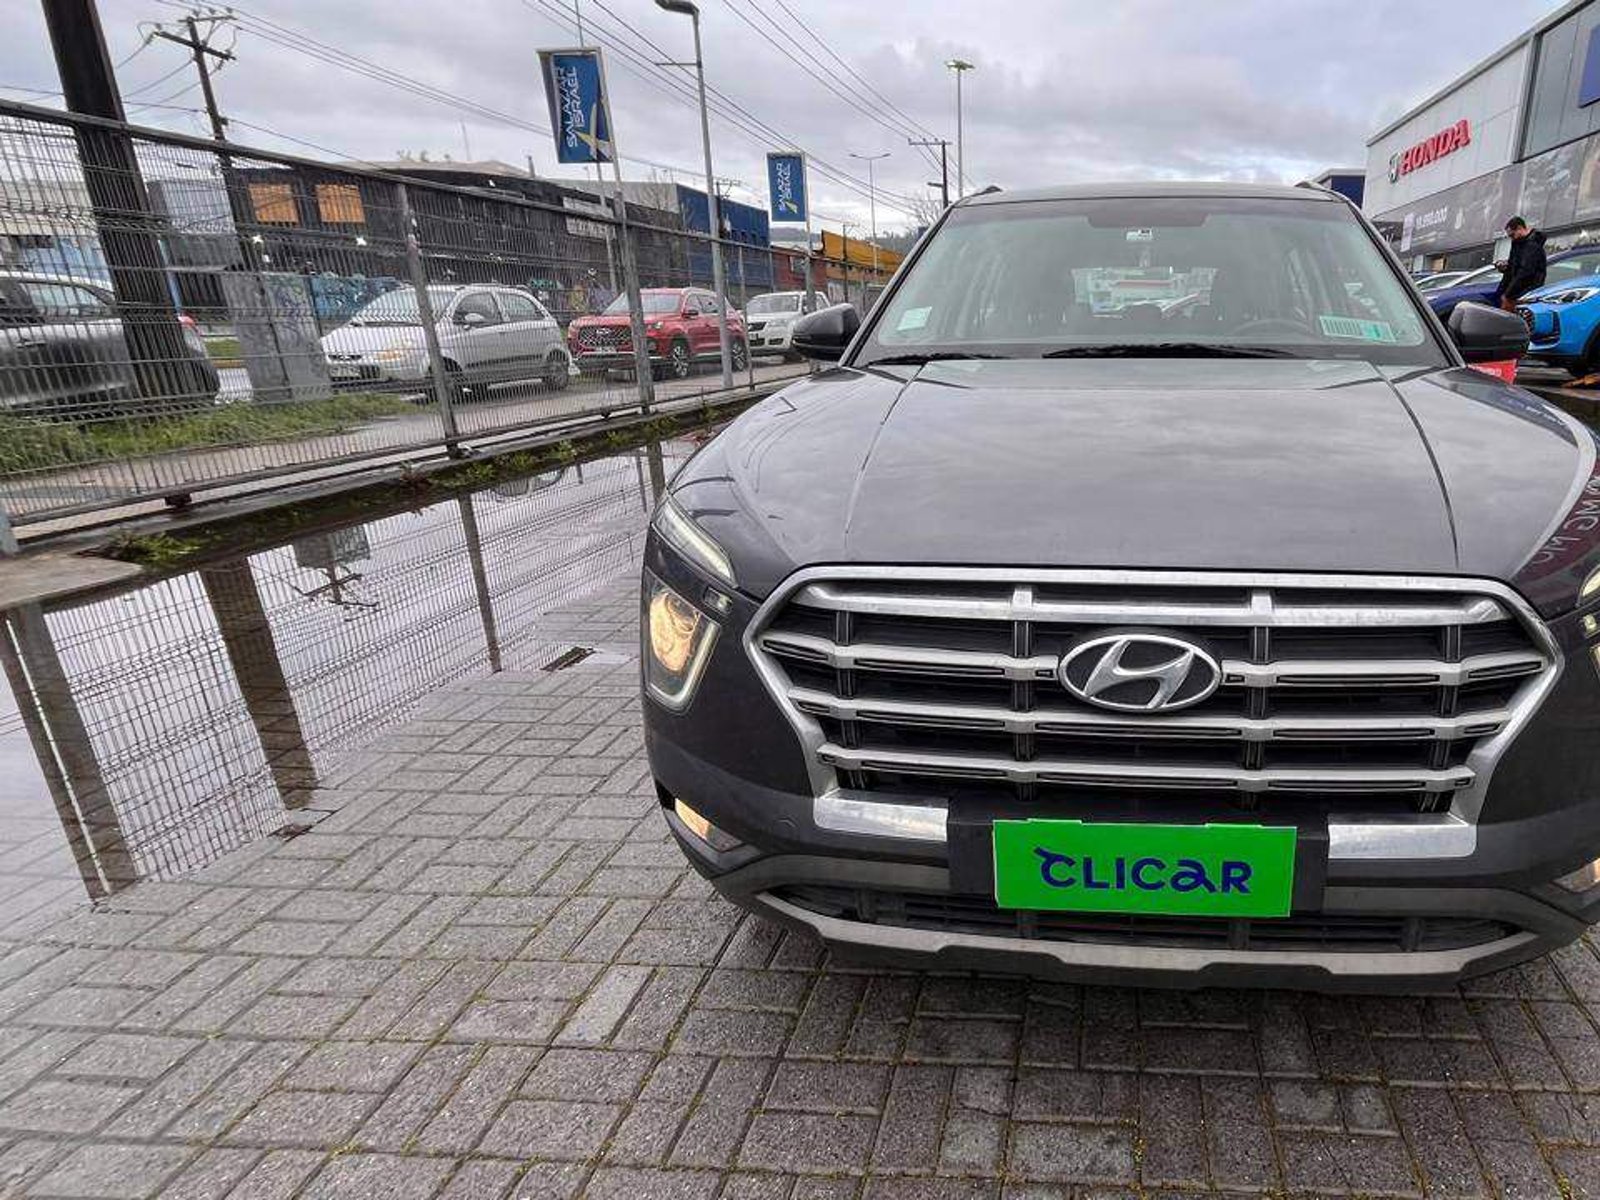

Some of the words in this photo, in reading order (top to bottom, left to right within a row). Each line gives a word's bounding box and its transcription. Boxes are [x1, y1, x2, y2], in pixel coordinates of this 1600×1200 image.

[554, 66, 578, 148] SALAZAR
[566, 66, 585, 128] ISRAEL
[1400, 119, 1472, 176] HONDA
